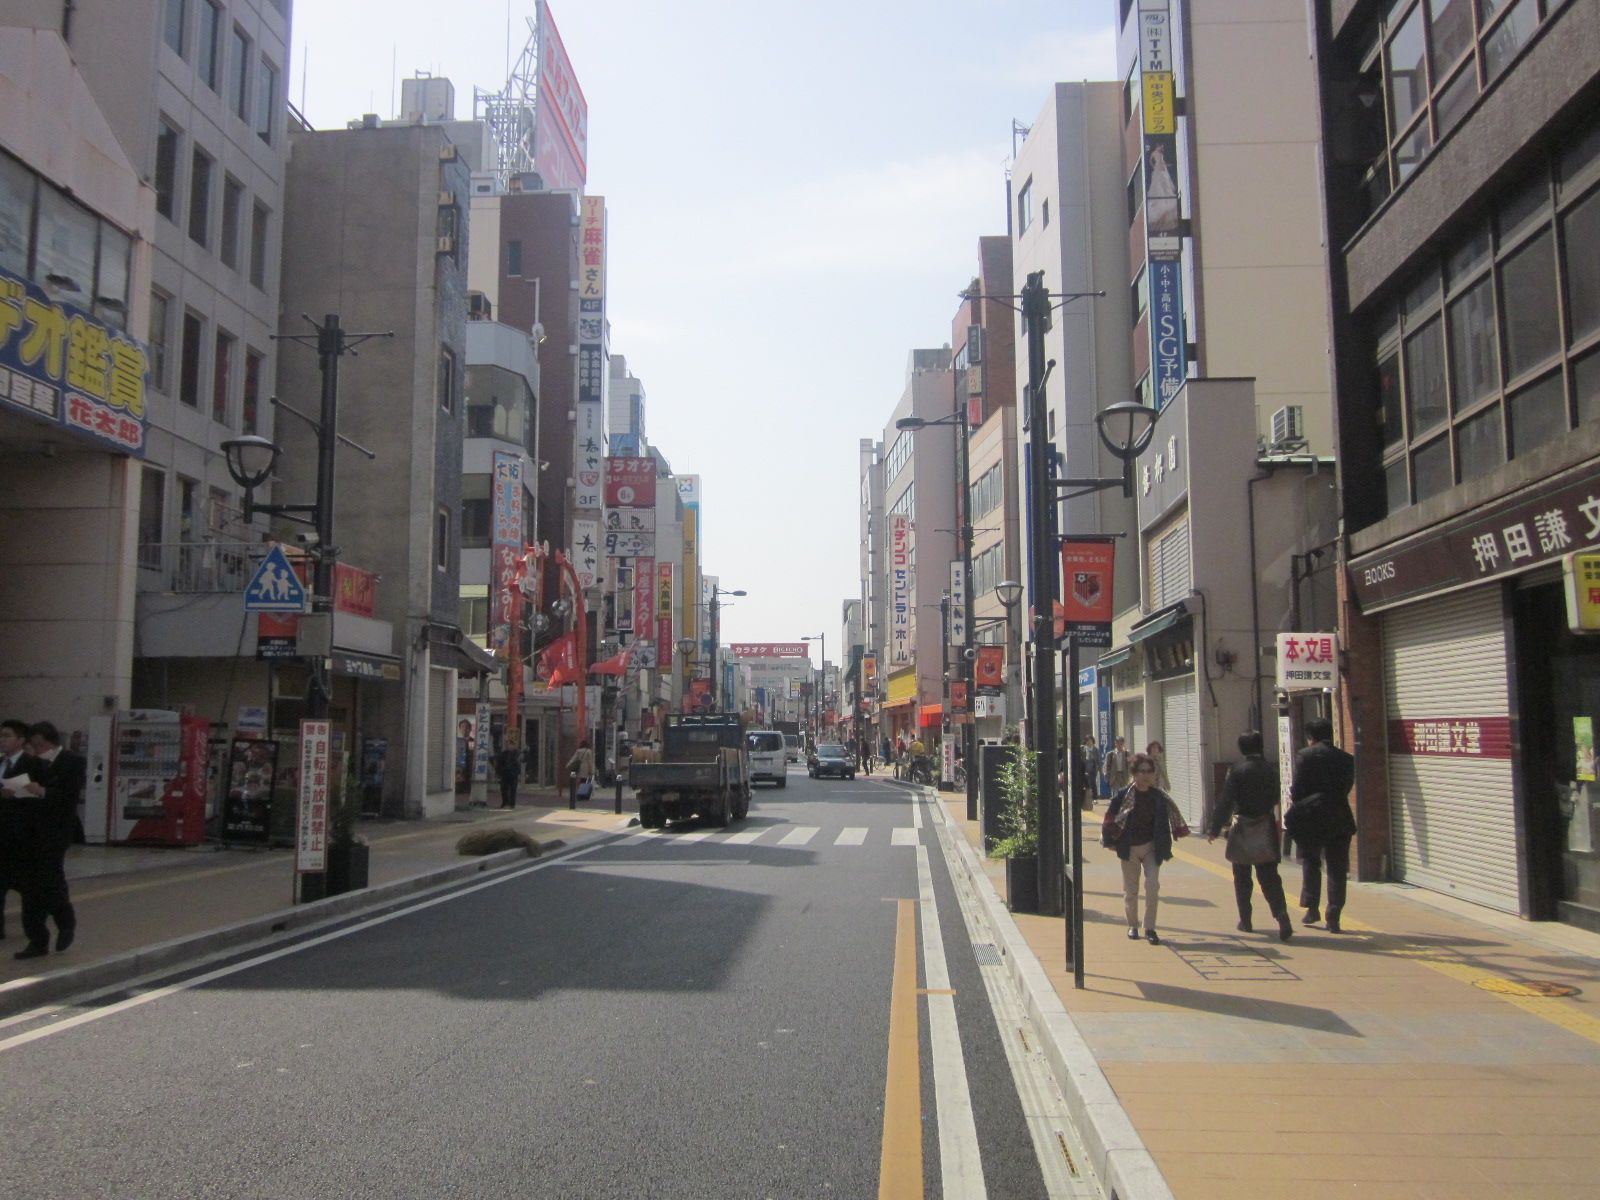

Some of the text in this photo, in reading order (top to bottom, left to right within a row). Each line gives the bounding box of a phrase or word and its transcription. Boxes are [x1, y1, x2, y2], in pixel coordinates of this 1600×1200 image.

[583, 301, 600, 311] 4F
[1159, 315, 1180, 408] SG予備
[69, 396, 140, 445] 花太郎
[496, 463, 520, 481] 大阪
[579, 495, 598, 505] 3F
[607, 511, 644, 530] 魚民
[894, 517, 906, 565] パチンコ
[1364, 561, 1396, 586] BOOKS
[952, 592, 963, 636] てんや
[734, 646, 768, 655] カラオケ
[1285, 637, 1333, 664] 本・文具
[1285, 670, 1332, 681] 押田謙文堂
[311, 740, 327, 852] 自転車放置禁止
